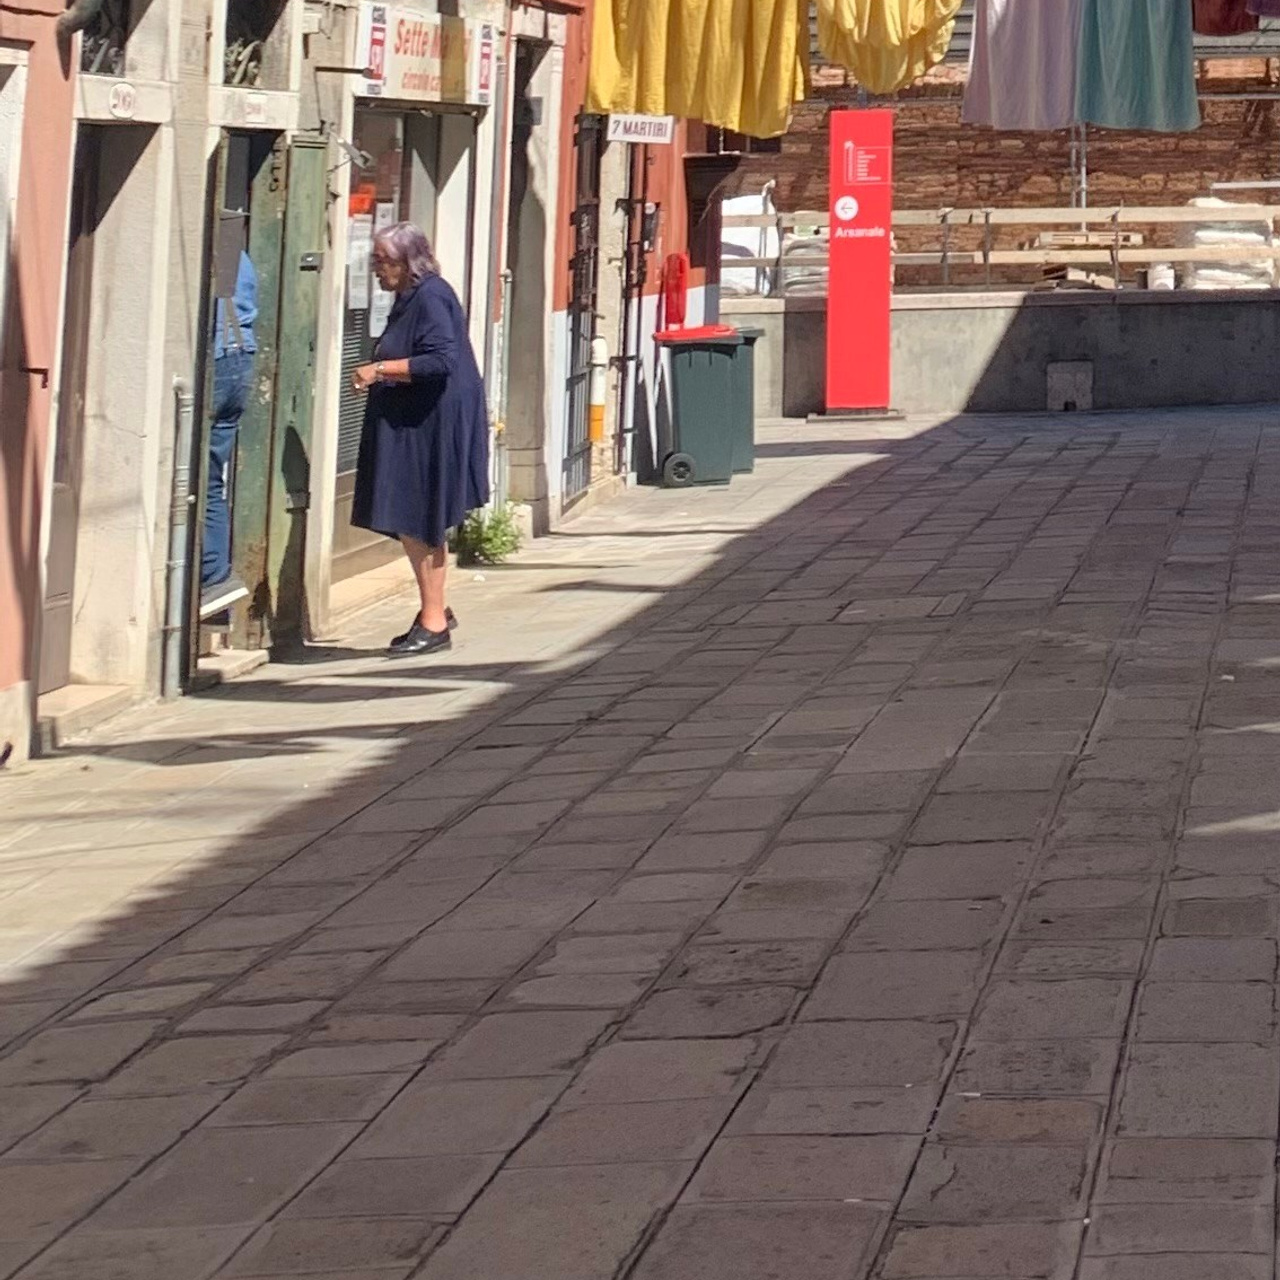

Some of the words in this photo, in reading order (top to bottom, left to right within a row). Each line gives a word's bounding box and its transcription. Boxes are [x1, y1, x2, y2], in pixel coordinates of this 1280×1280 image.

[394, 18, 428, 58] Sette
[611, 120, 621, 135] 7
[623, 120, 669, 138] MARTIRI
[834, 225, 886, 238] Arsenale
